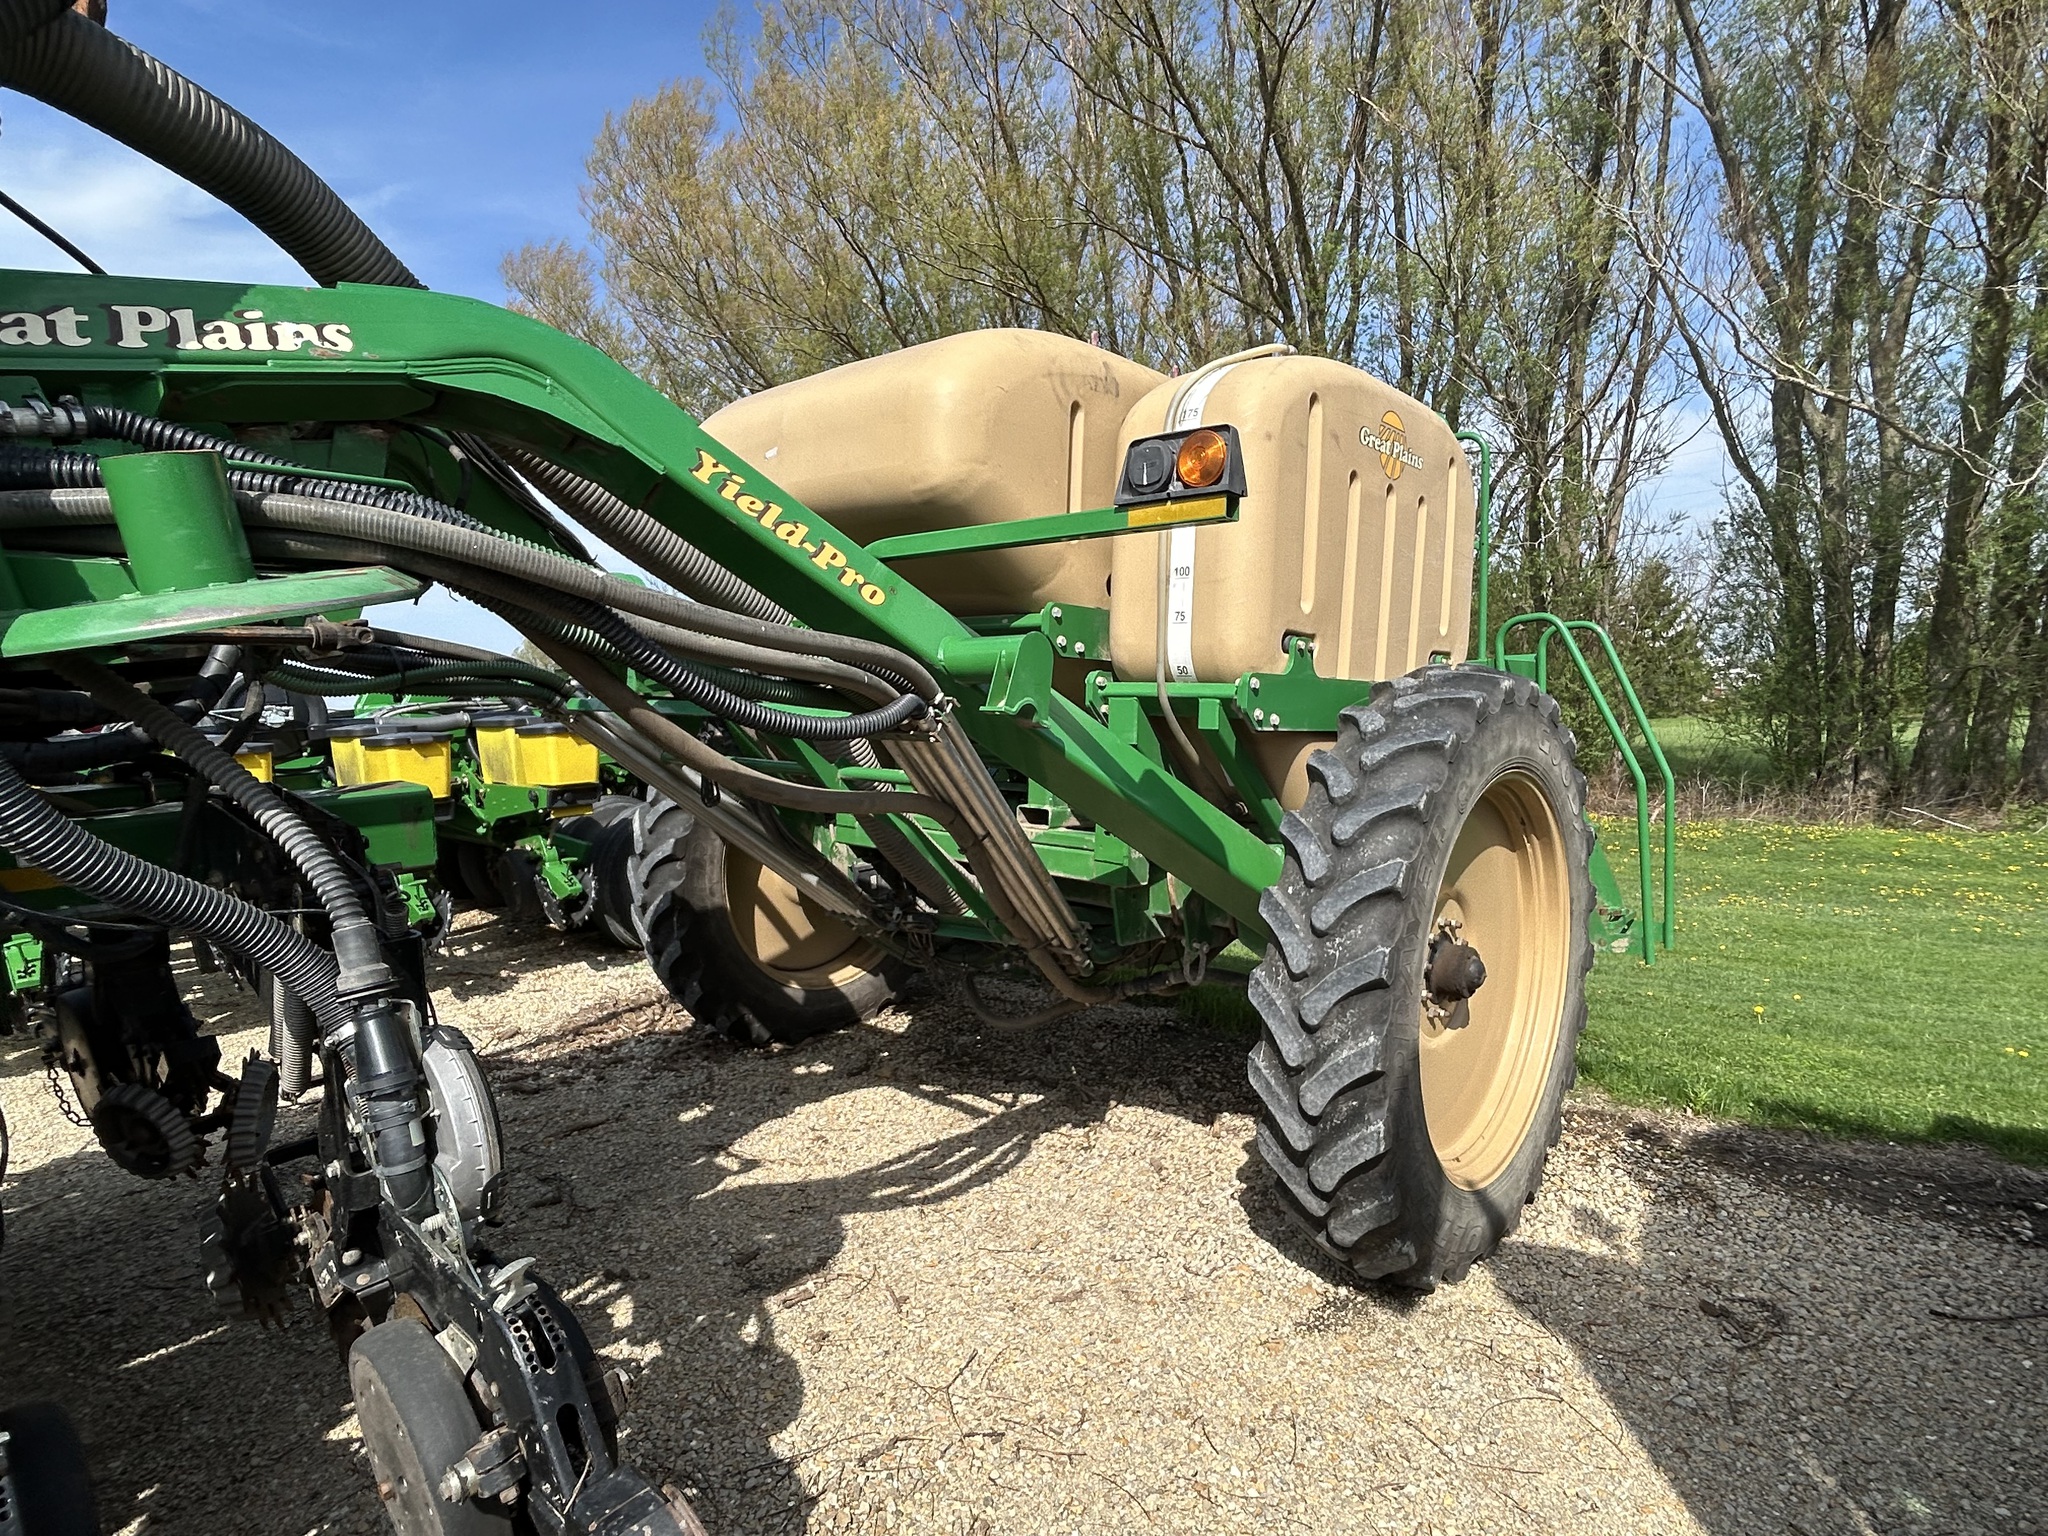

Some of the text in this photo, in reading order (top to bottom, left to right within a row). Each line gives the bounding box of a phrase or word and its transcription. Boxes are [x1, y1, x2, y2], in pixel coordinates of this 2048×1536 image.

[110, 304, 354, 353] Plains
[1183, 407, 1199, 419] 175
[1359, 425, 1424, 470] Great Plains
[689, 448, 886, 606] Yield-Pro
[1174, 566, 1190, 577] 100
[1175, 611, 1186, 621] 75
[1176, 665, 1189, 675] 50
